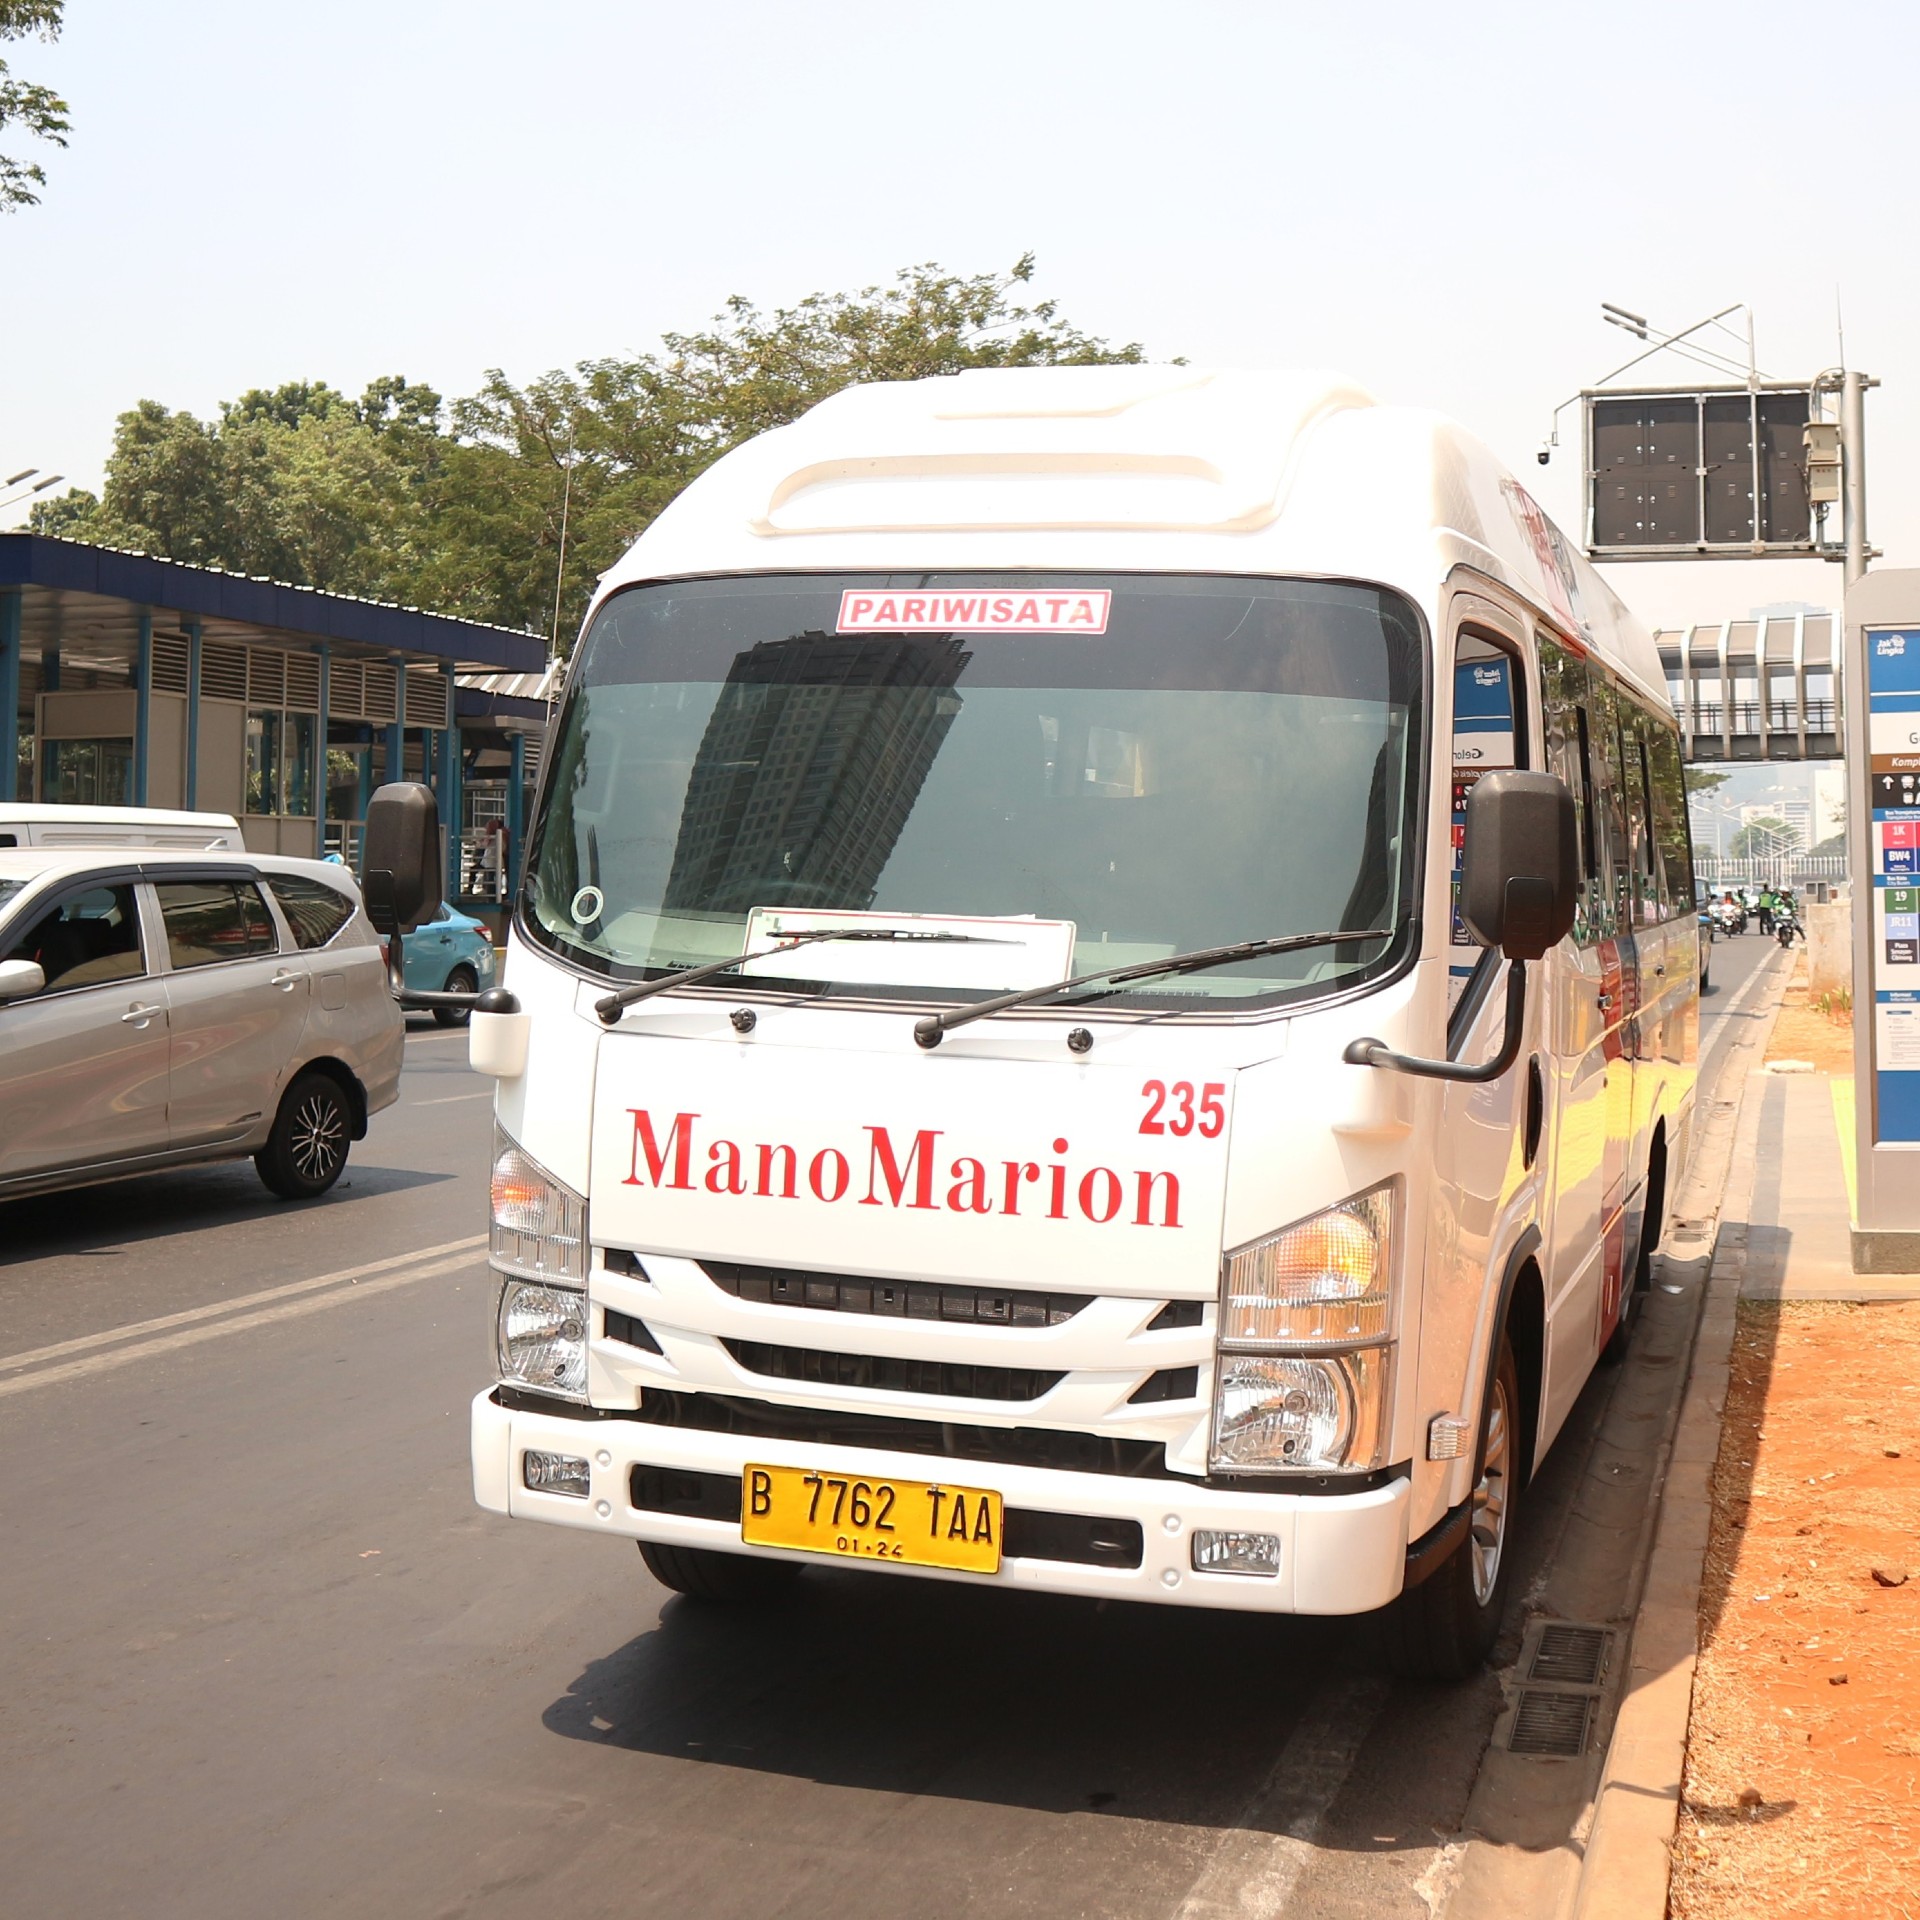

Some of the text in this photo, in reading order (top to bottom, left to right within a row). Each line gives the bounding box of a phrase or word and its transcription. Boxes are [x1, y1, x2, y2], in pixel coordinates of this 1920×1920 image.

[849, 598, 1096, 624] PARIWISATA
[1909, 731, 1920, 745] G
[1888, 850, 1911, 862] BW4
[1894, 890, 1908, 902] 19
[1890, 916, 1913, 928] JR11
[1138, 1079, 1226, 1138] 235
[751, 1471, 993, 1544] B 7762 TAA
